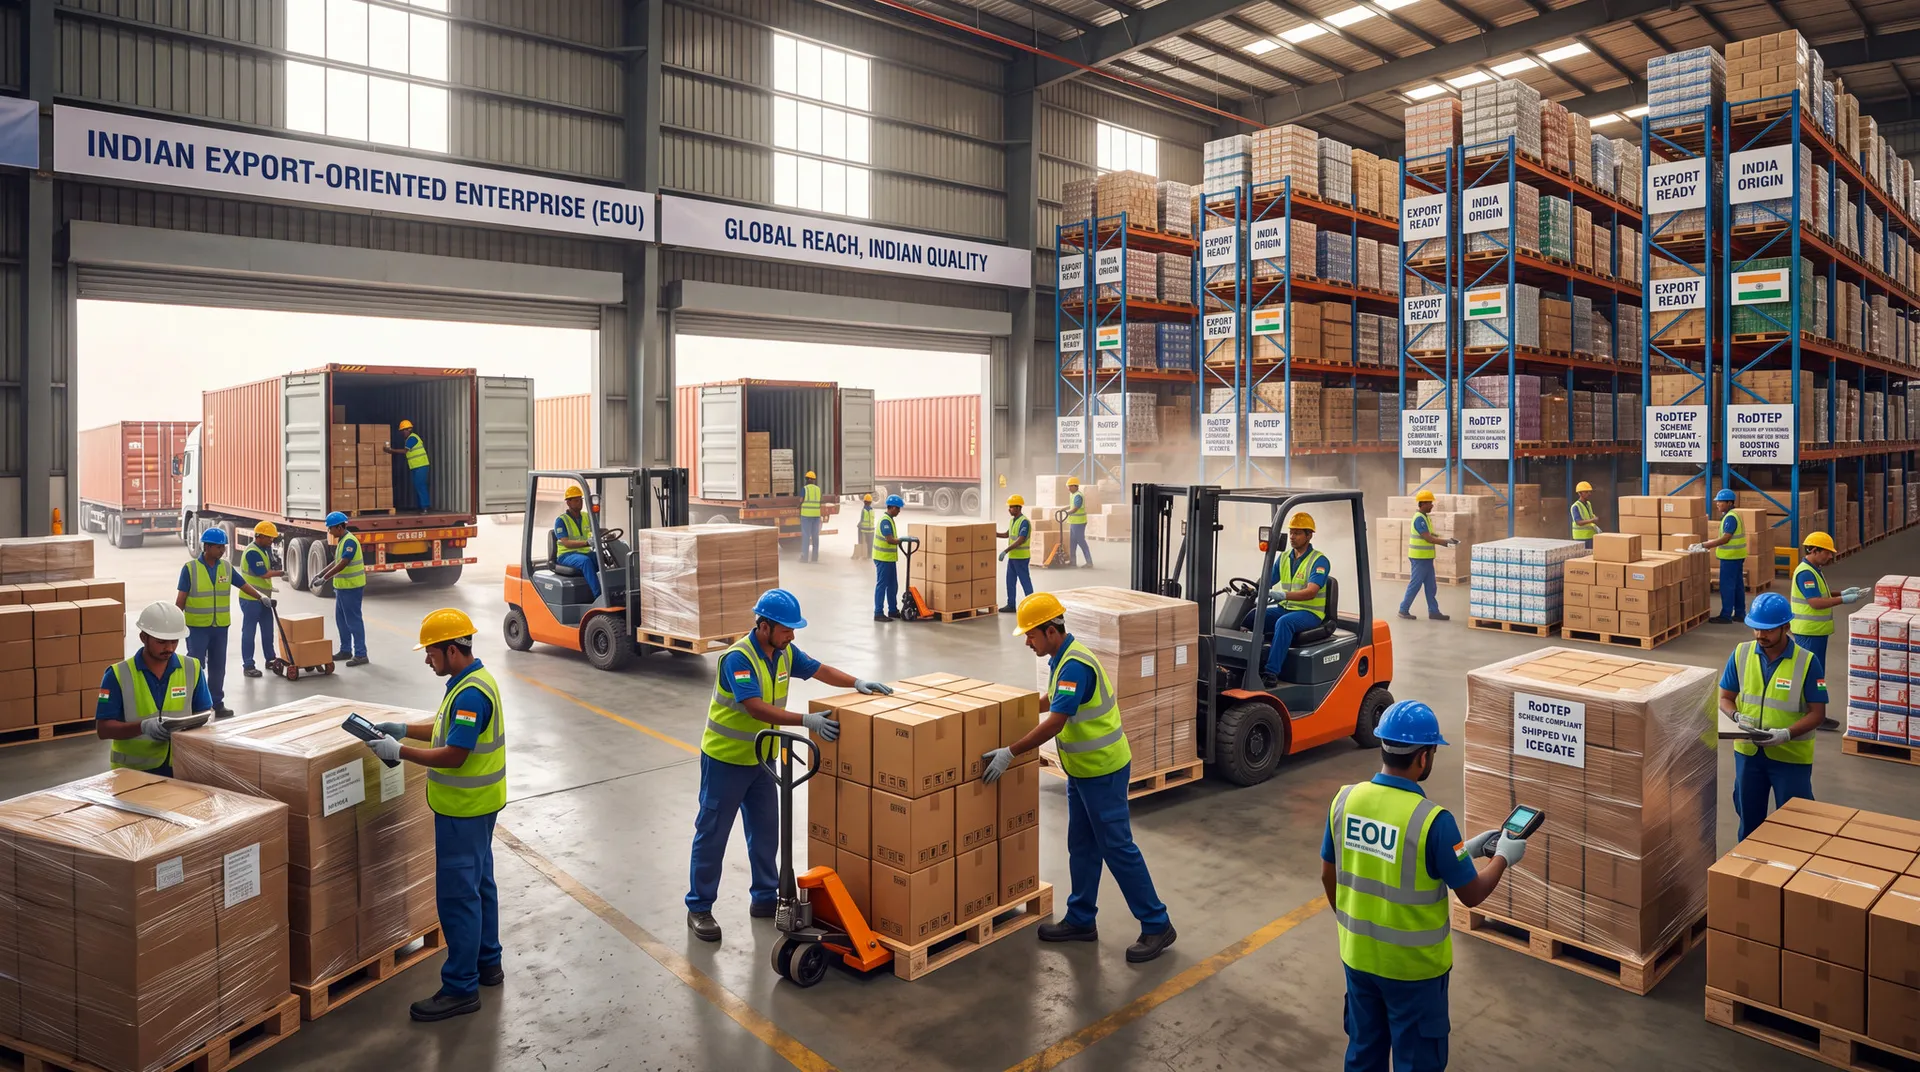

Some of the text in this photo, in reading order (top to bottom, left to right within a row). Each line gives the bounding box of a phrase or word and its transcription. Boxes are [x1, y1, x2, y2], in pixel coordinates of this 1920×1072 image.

[1742, 160, 1778, 175] INDIA
[87, 129, 645, 232] INDIAN EXPORT-ORIENTED ENTERPRISE (EOU)
[1653, 170, 1700, 187] EXPORT
[1738, 174, 1784, 190] ORIGIN
[1656, 185, 1697, 200] READY
[1472, 195, 1499, 208] INDIA
[1407, 204, 1443, 218] EXPORT
[1469, 208, 1503, 221] ORIGIN
[1410, 217, 1440, 229] READY
[1257, 228, 1278, 238] INDIA
[724, 217, 988, 272] GLOBAL REACH, INDIAN QUALITY
[1205, 235, 1233, 248] EXPORT
[1255, 238, 1281, 250] ORIGIN
[1207, 246, 1231, 258] READY
[1063, 271, 1080, 280] READY
[1099, 265, 1119, 275] ORIGIN
[1655, 281, 1700, 294] EXPORT
[1408, 298, 1442, 310] EXPORT
[1659, 294, 1697, 306] READY
[1411, 309, 1440, 320] READY
[1207, 316, 1233, 326] EXPORT
[1209, 326, 1231, 336] READY
[1409, 415, 1440, 424] RoDTEP
[1469, 416, 1502, 425] RoDTEP
[1656, 412, 1697, 422] RoDTEP
[1737, 413, 1782, 423] RoDTEP
[1742, 450, 1777, 458] EXPORTS
[1528, 700, 1571, 716] RoDTEP
[1518, 712, 1582, 730] SCHEME COMPLIANT
[1522, 726, 1577, 743] SHIPPED VIA
[1526, 739, 1575, 758] ICEGATE
[1346, 817, 1397, 850] EOU
